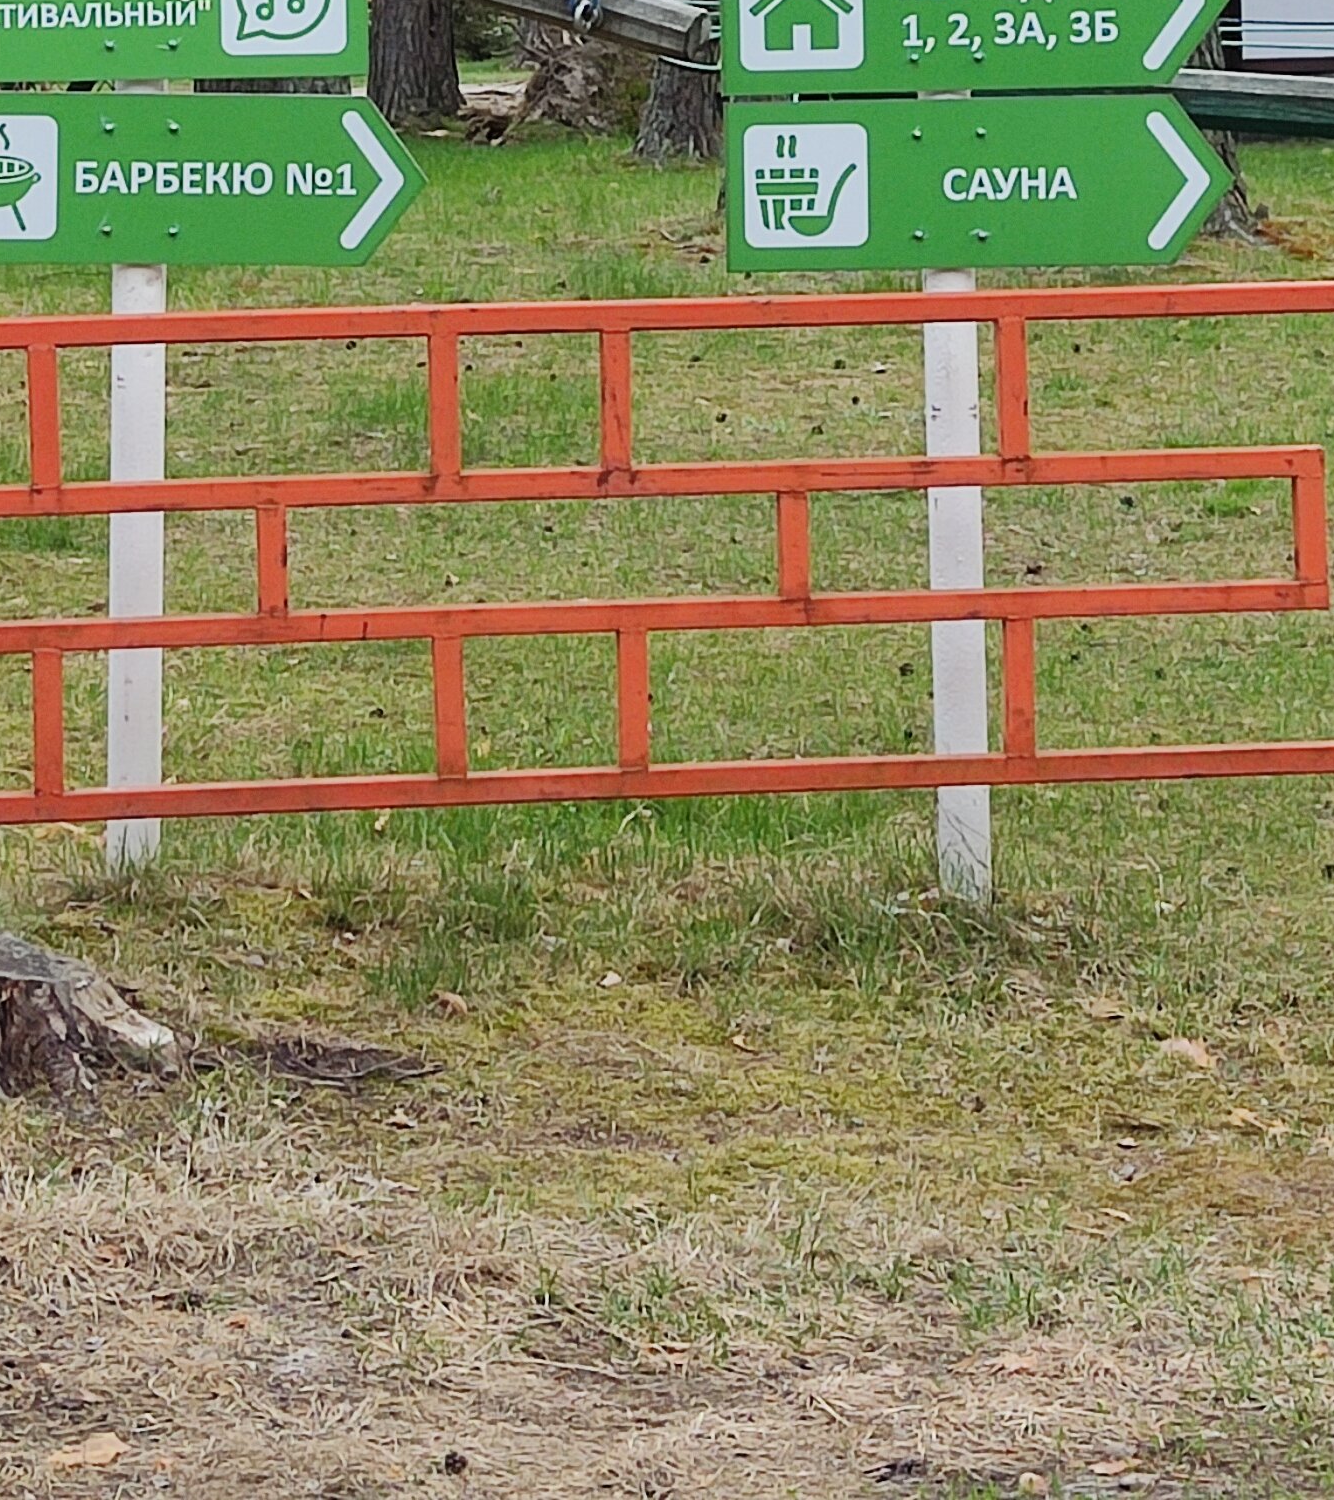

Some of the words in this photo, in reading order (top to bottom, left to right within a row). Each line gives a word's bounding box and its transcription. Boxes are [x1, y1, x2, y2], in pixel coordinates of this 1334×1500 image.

[902, 14, 936, 54] 1,
[947, 13, 983, 52] 2,
[75, 161, 273, 195] БАРБЕКЮ
[286, 163, 356, 196] №1
[942, 167, 1077, 200] САУНА
